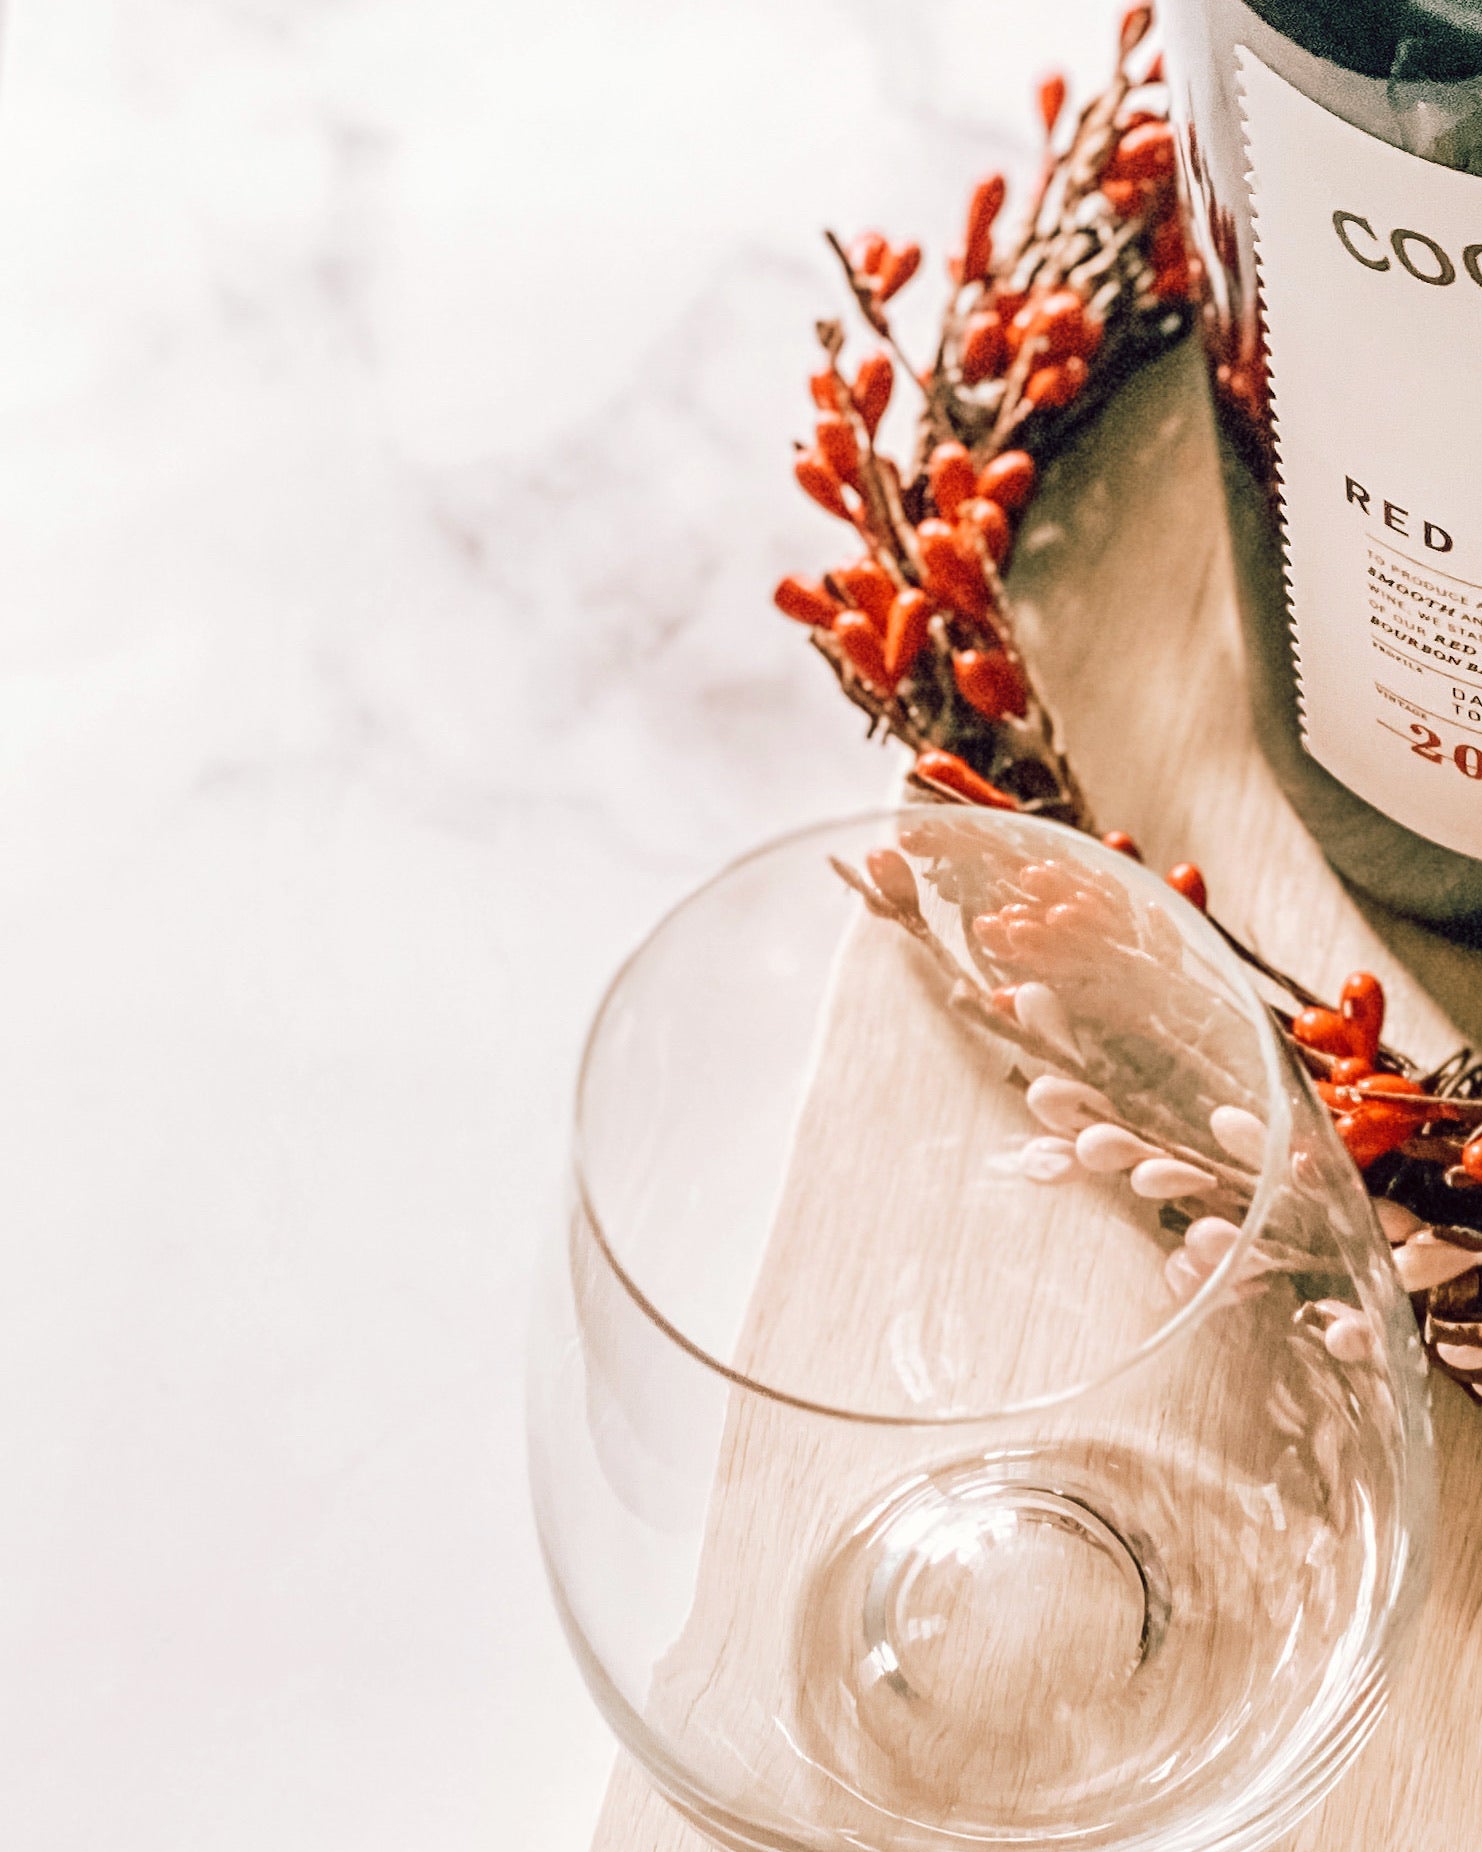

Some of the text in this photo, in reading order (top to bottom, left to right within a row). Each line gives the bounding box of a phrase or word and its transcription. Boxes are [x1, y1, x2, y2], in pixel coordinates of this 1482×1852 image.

[1345, 475, 1454, 553] RED
[1367, 565, 1456, 617] SMOOTH
[1391, 564, 1468, 606] PRODUCE
[1370, 615, 1462, 666] BOURBON
[1393, 614, 1426, 637] OUR
[1434, 634, 1477, 656] RED
